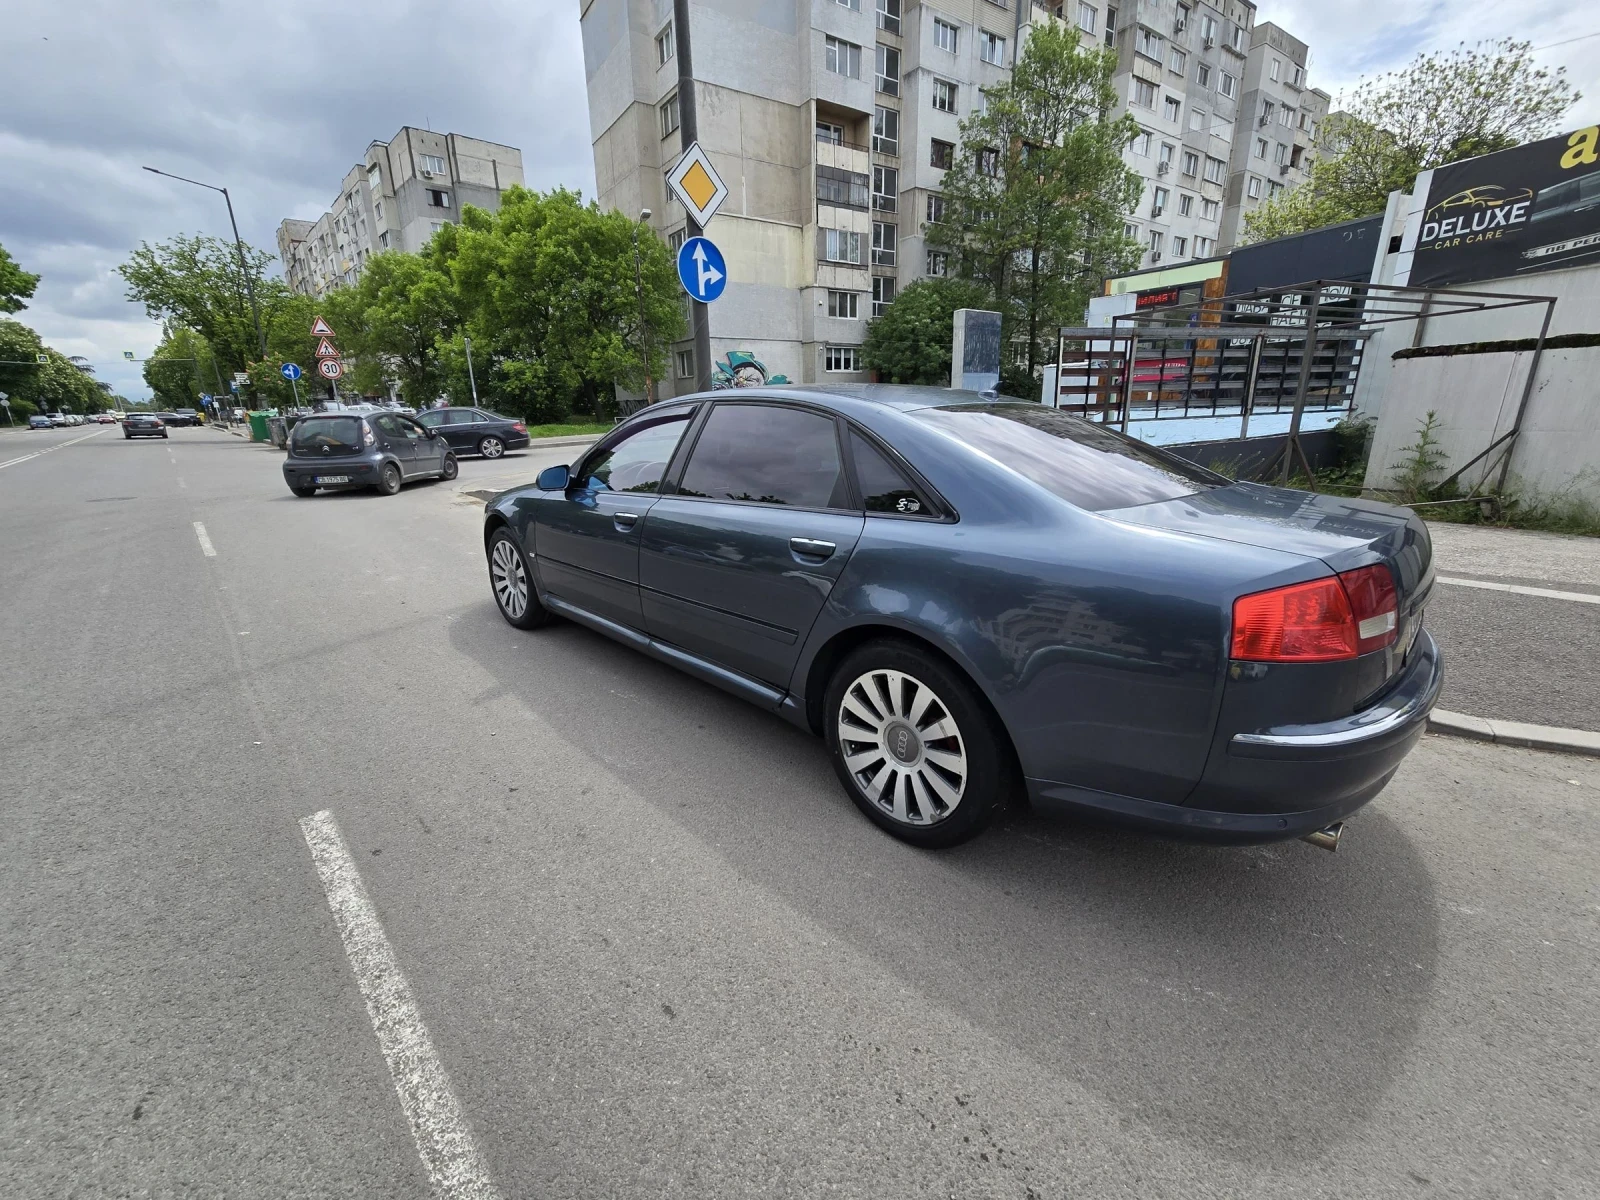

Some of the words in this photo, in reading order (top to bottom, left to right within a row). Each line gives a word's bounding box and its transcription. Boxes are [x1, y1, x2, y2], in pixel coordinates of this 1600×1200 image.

[1421, 201, 1531, 242] DELUXE
[1434, 238, 1461, 250] CAR
[1466, 229, 1504, 244] CARE
[324, 363, 337, 374] 30
